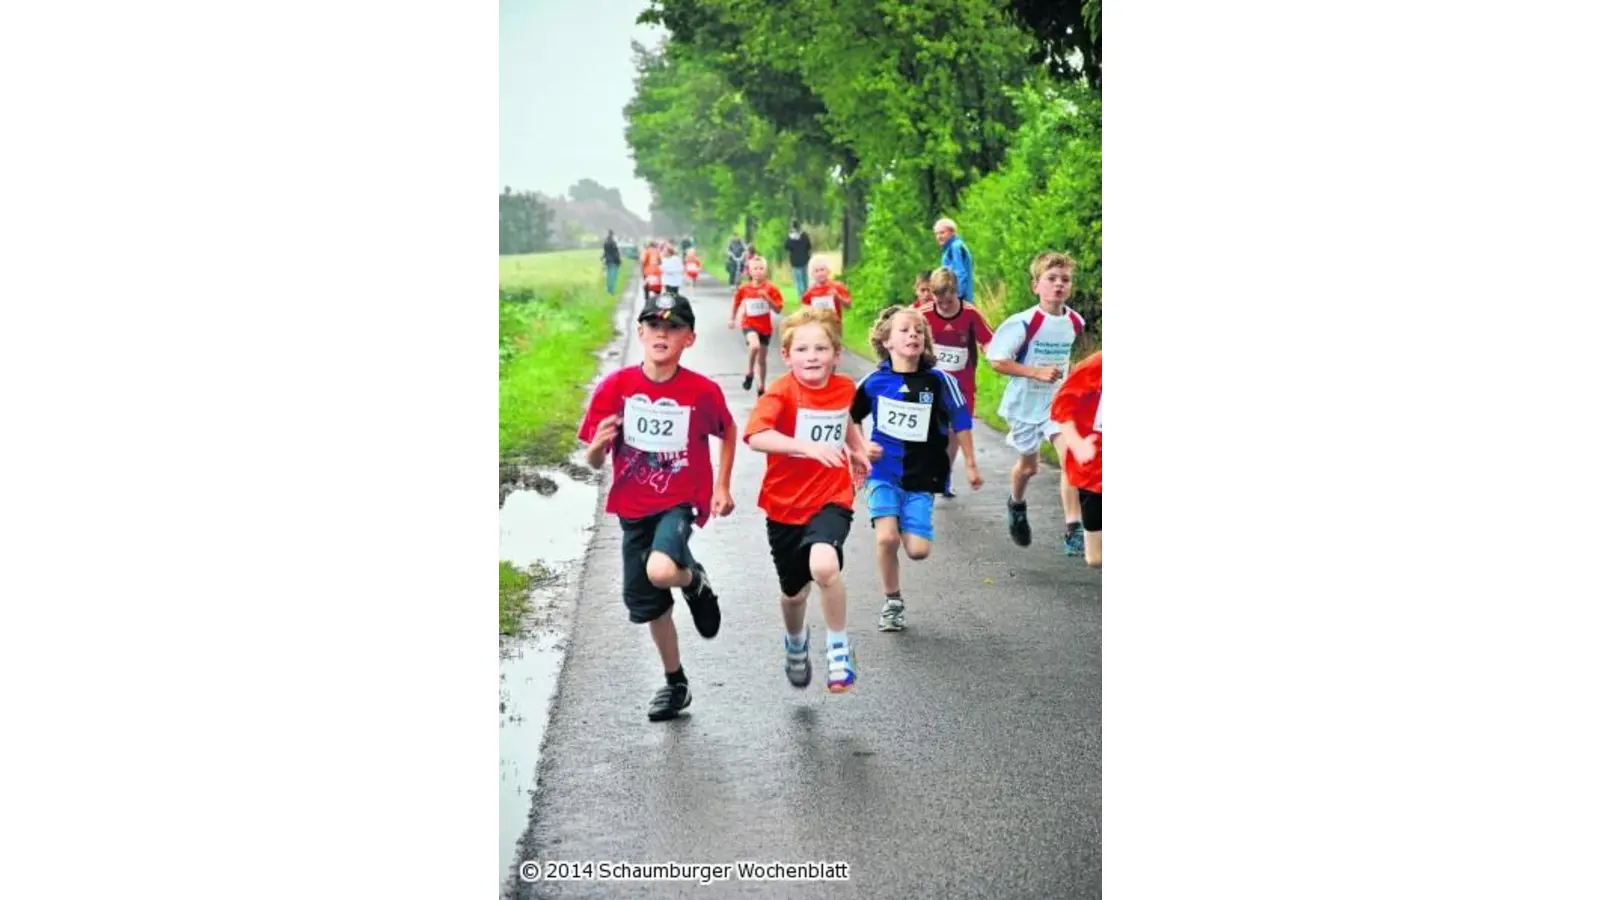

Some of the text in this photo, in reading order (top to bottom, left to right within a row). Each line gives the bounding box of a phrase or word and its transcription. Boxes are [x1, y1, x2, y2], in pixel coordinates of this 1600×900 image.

[940, 352, 960, 364] 223
[637, 417, 674, 436] 032
[888, 411, 918, 429] 275
[811, 423, 842, 442] 078
